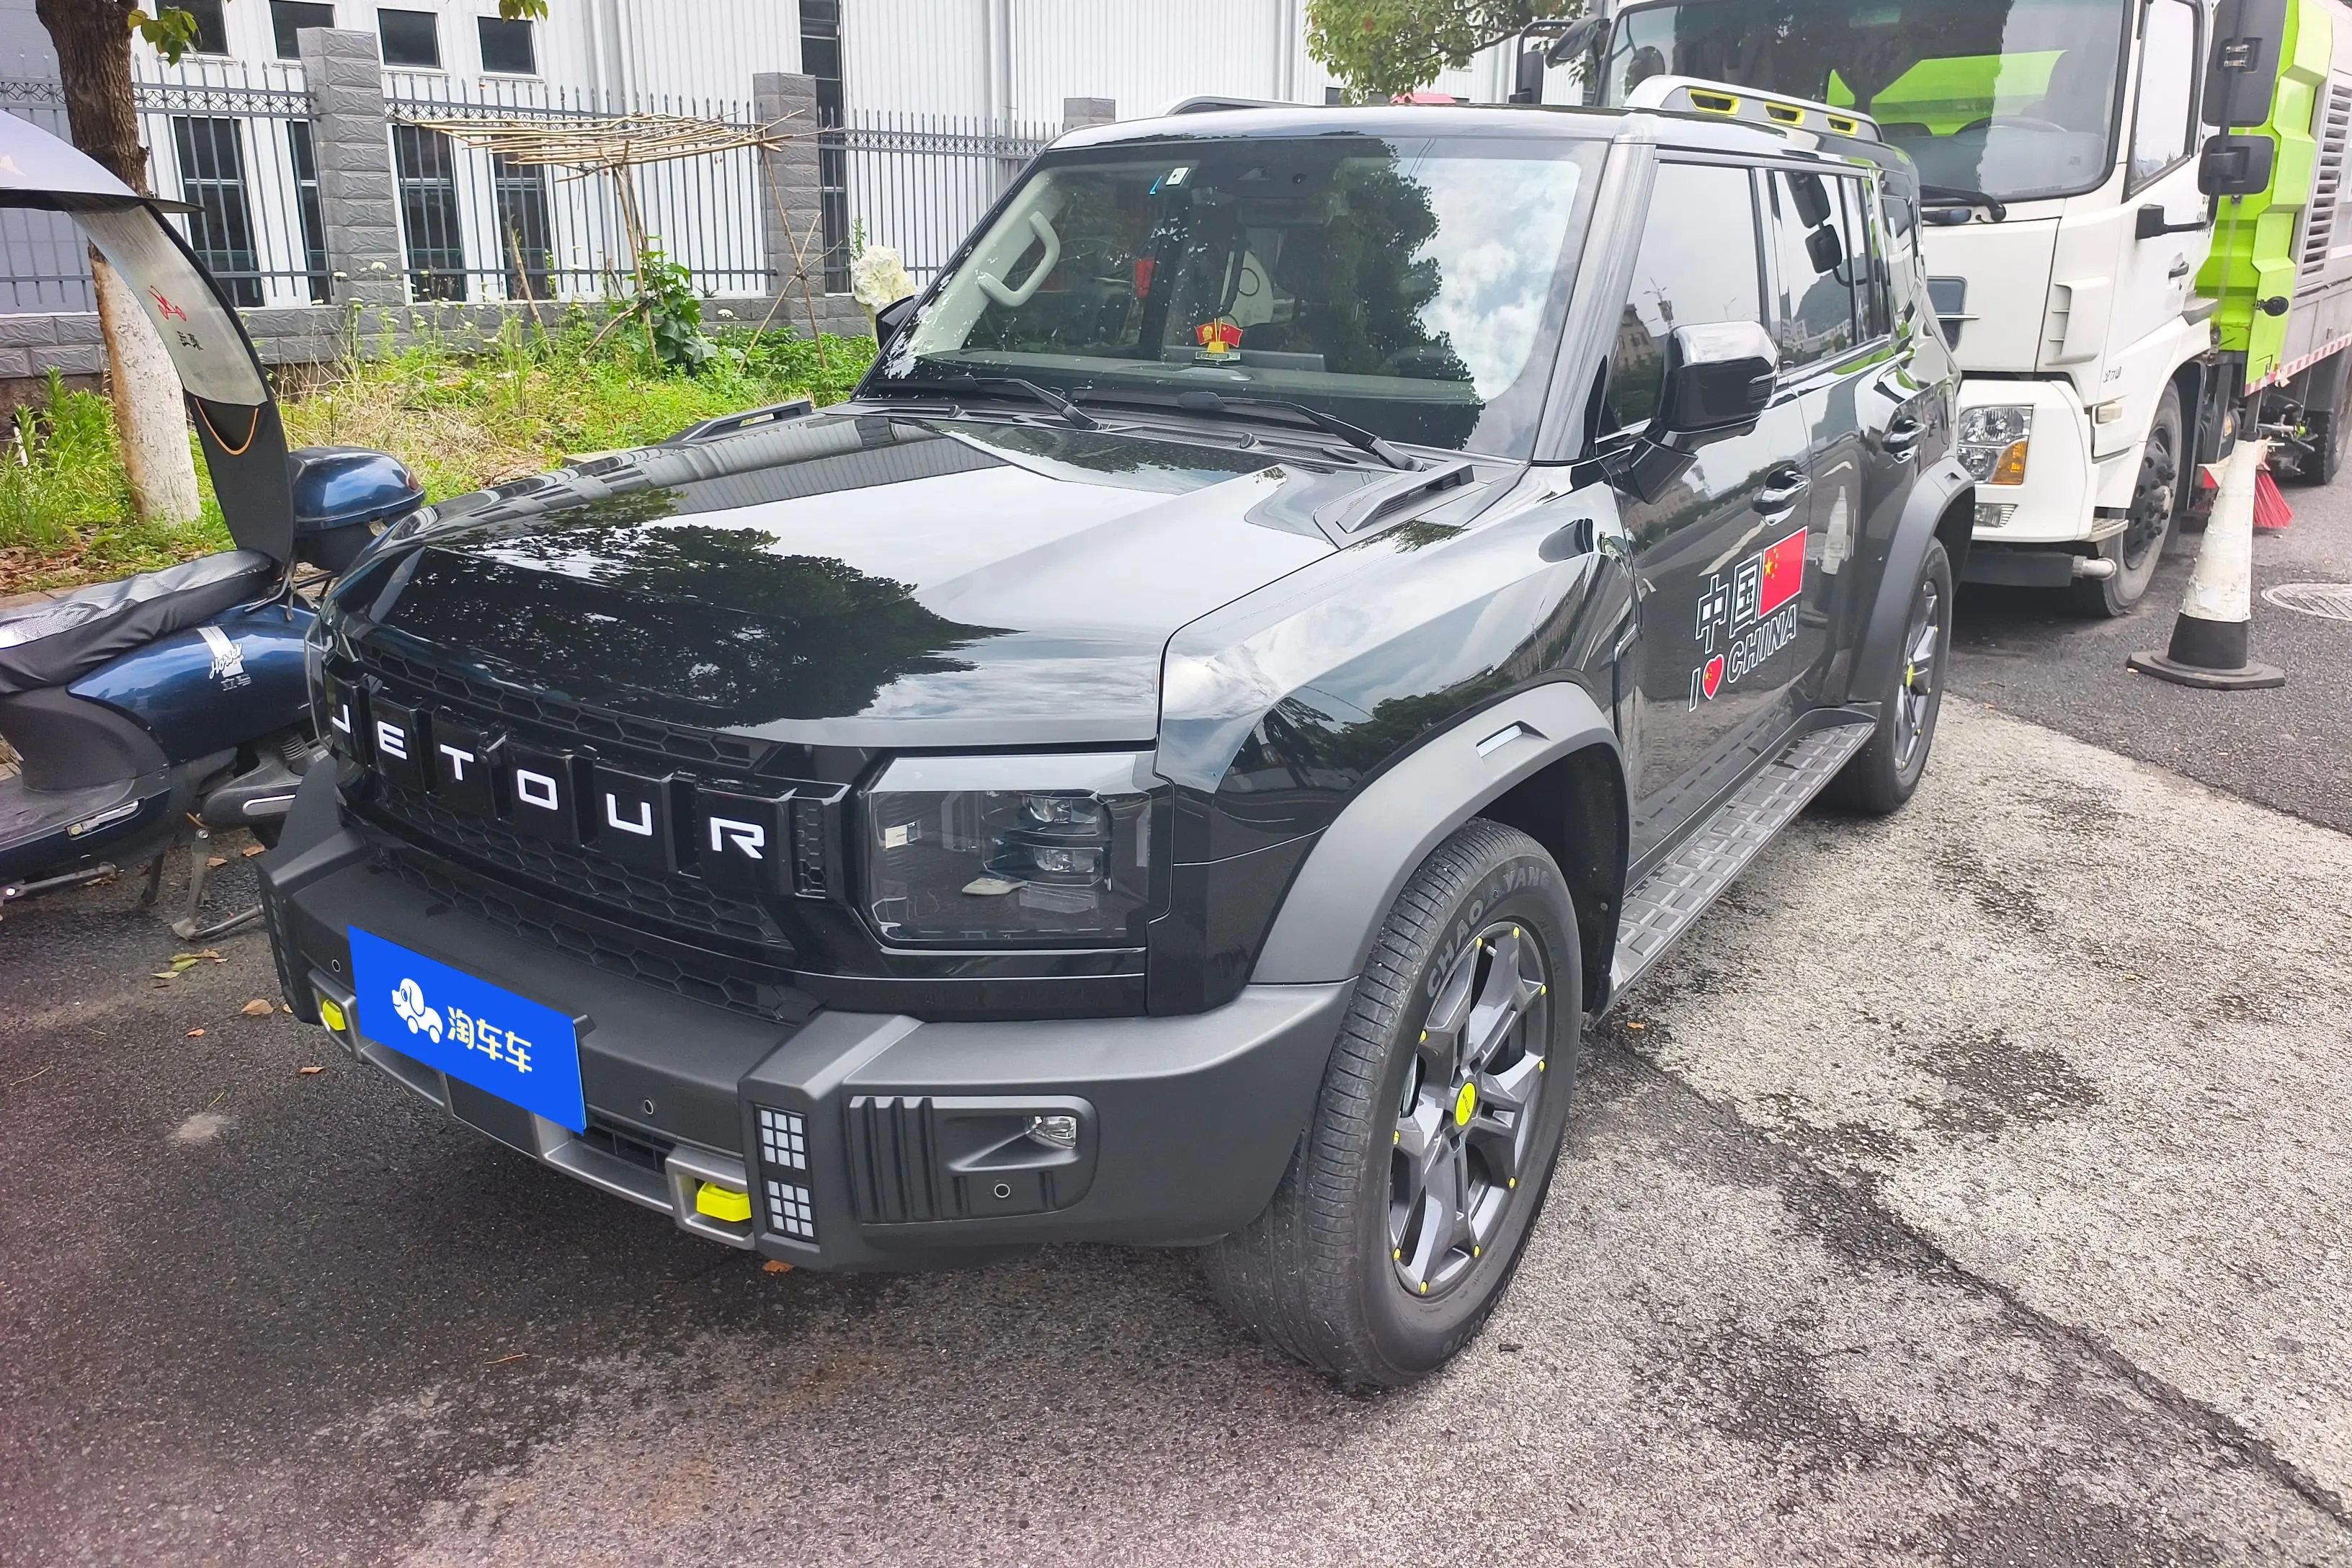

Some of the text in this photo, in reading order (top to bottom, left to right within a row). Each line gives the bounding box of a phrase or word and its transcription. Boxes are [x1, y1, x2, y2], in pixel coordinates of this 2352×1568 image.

[1688, 603, 1797, 712] I CHINA
[1695, 551, 1763, 655] 中国
[331, 703, 766, 860] JETOUR
[1427, 899, 1484, 998] CHAO
[1502, 866, 1550, 893] YANG
